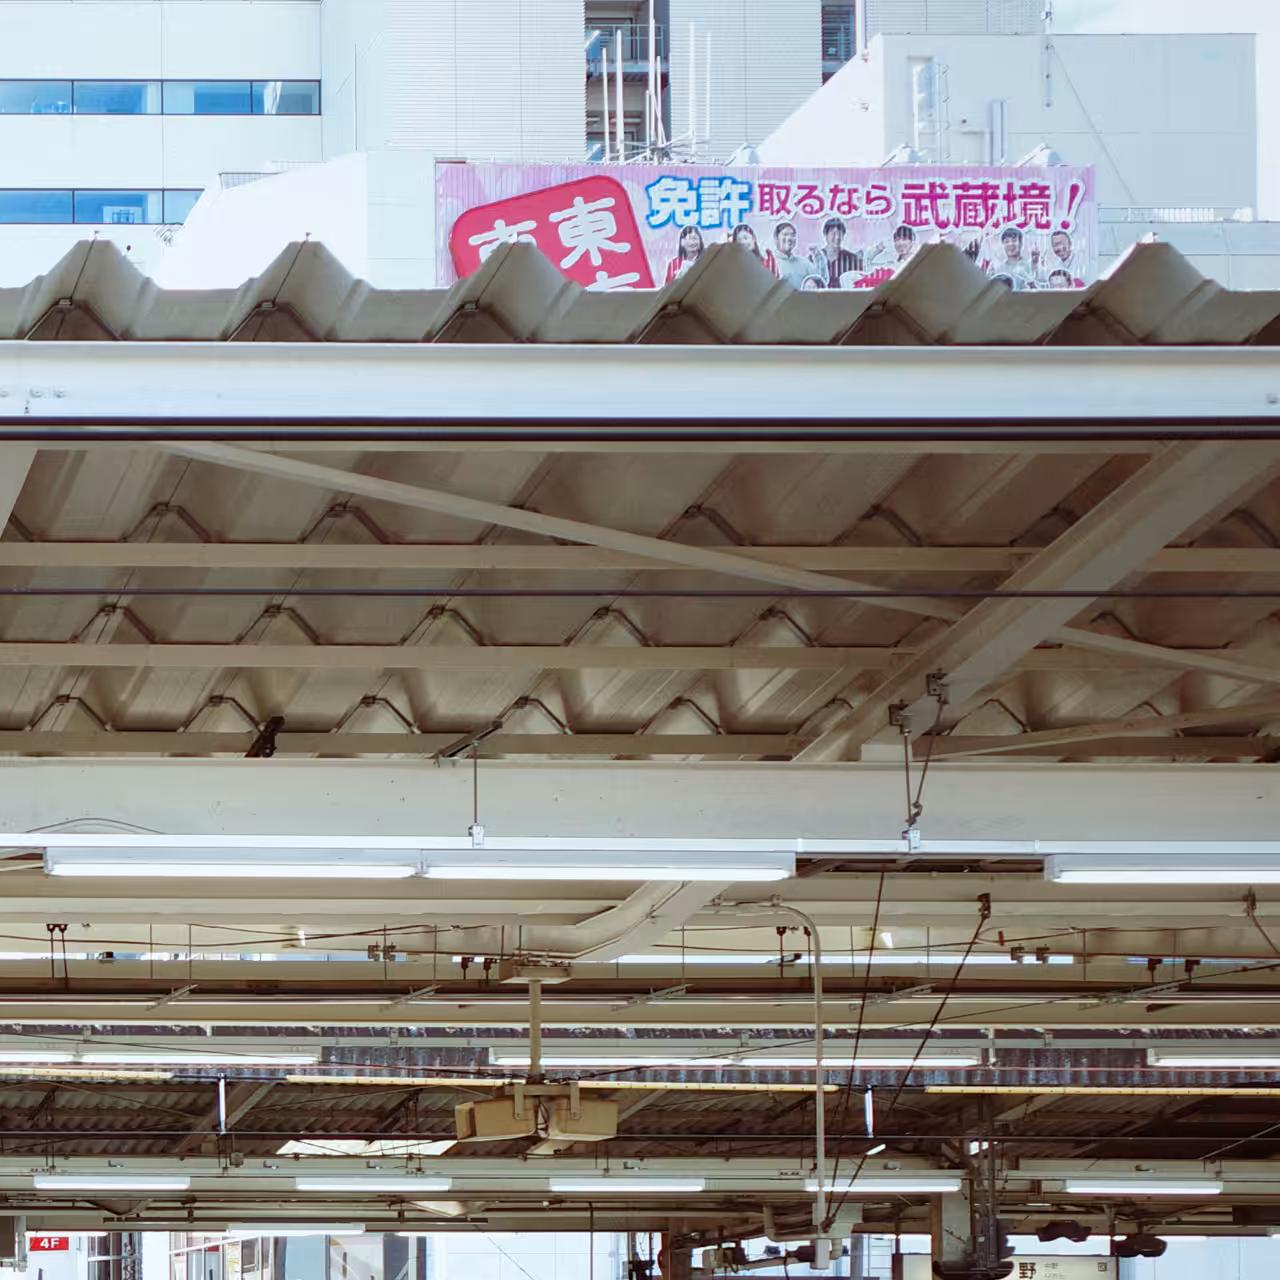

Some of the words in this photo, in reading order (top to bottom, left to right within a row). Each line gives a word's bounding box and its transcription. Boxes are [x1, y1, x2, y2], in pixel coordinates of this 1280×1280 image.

[646, 175, 754, 230] 免許
[757, 182, 893, 218] 取るなら
[40, 1238, 60, 1248] 4F
